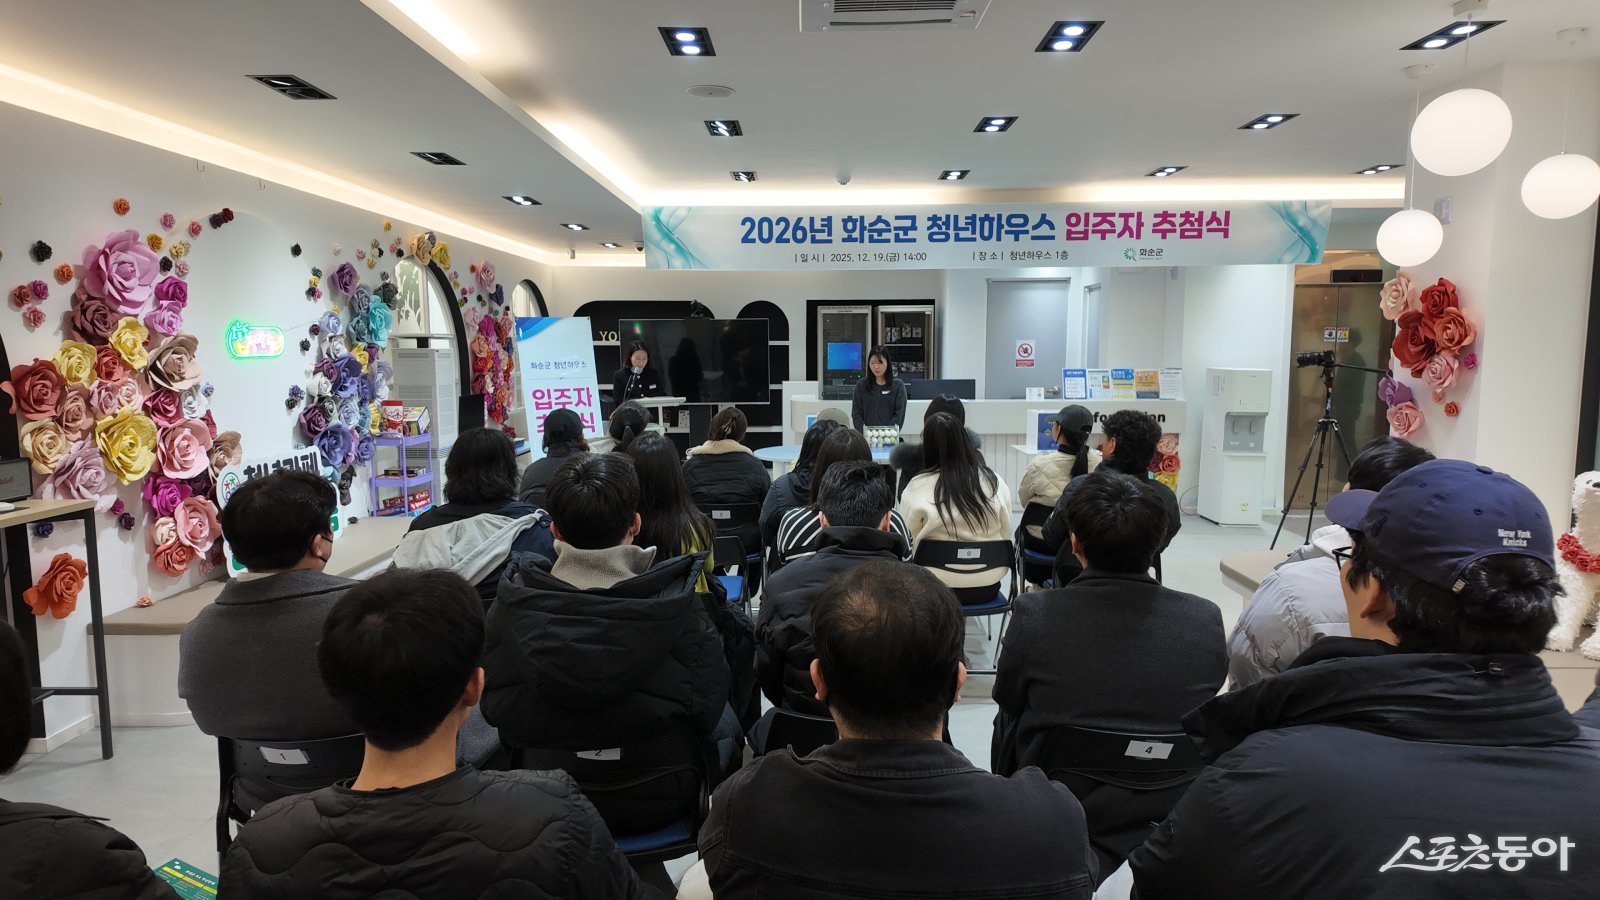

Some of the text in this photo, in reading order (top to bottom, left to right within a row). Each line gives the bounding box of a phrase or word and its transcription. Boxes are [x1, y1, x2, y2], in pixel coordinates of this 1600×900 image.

[740, 210, 1231, 244] 2026년 화순군 청년하우스 입주자 추첨식
[830, 253, 854, 262] 2025.
[857, 253, 870, 262] 12.
[873, 252, 900, 263] 19.(금)
[903, 252, 927, 261] 14:00
[1009, 250, 1052, 260] 청년하우스
[1055, 250, 1069, 260] 1층
[1138, 248, 1164, 257] 화순군
[530, 360, 588, 370] 화순군 청년하우스
[531, 387, 593, 411] 입주자
[1497, 528, 1532, 539] New York
[1502, 538, 1528, 547] Knicks
[1144, 746, 1154, 754] 4
